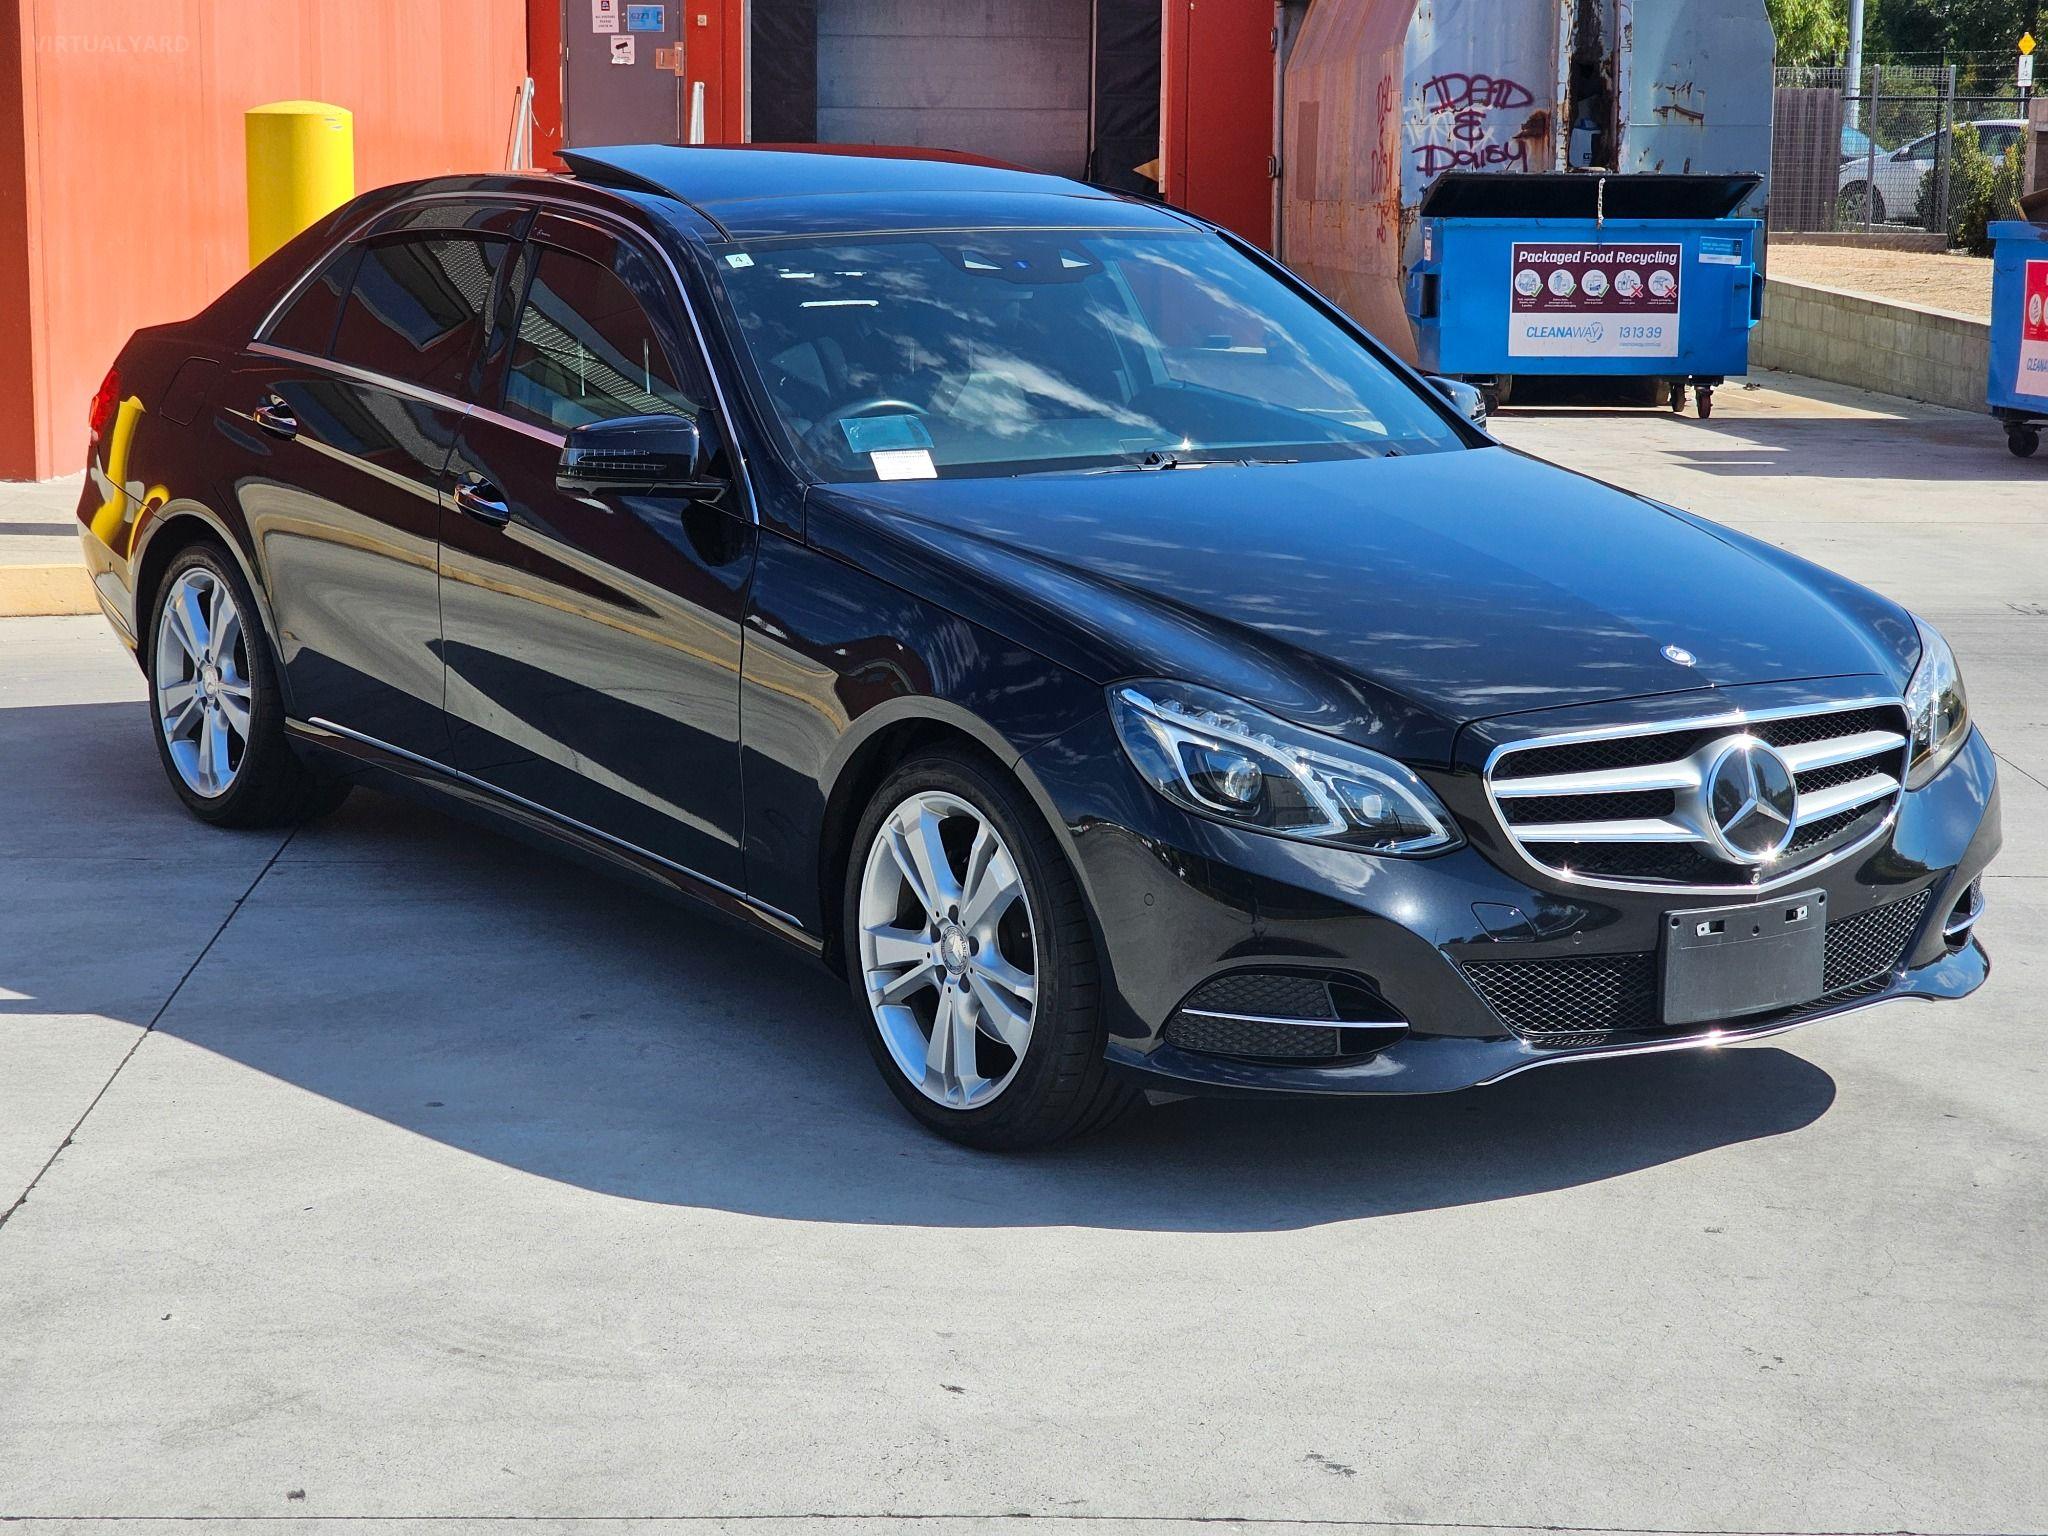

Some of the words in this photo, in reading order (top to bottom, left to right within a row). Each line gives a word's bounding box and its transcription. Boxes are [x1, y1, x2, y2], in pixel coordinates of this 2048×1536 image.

[1519, 251, 1581, 265] Packaged
[1584, 252, 1614, 264] Food
[1616, 251, 1677, 266] Recycling
[1526, 326, 1600, 338] CLEANAWAY
